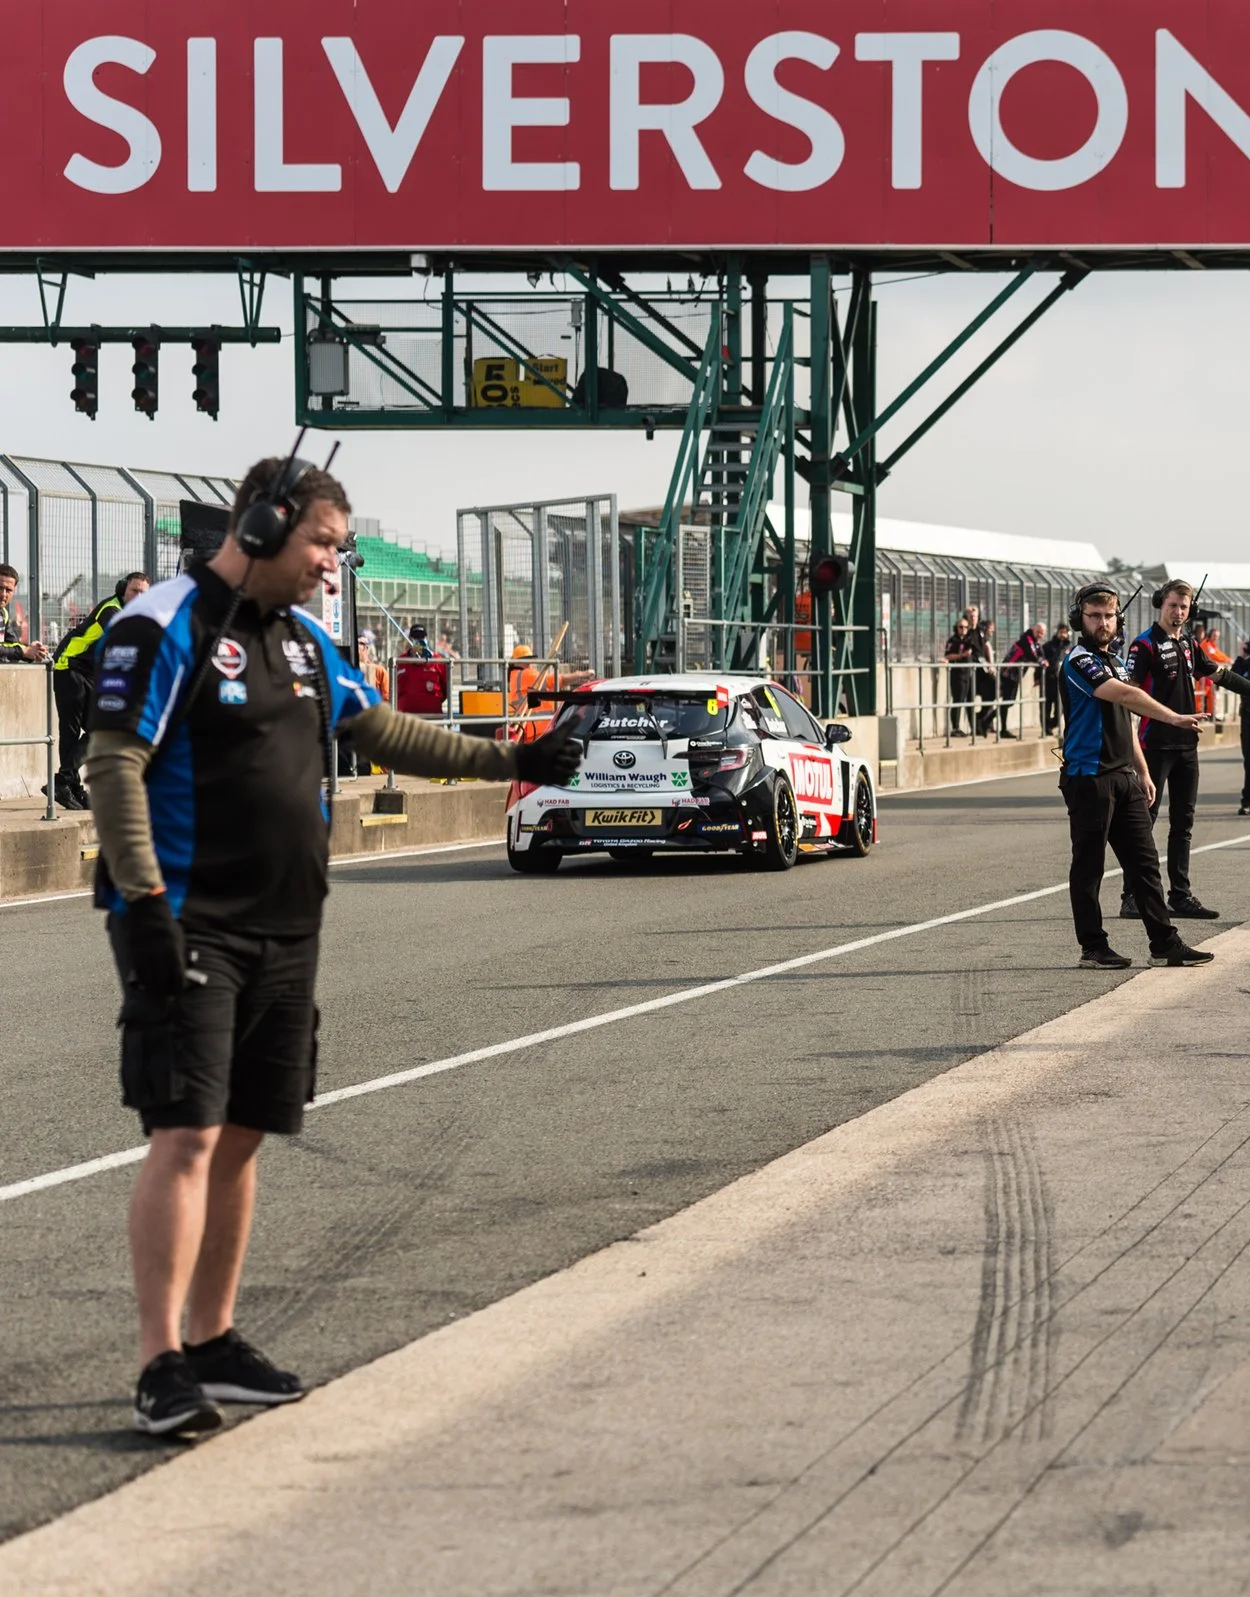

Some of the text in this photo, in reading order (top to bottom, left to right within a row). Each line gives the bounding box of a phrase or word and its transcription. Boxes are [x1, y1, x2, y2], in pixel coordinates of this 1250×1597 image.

[707, 699, 719, 716] 6
[598, 716, 668, 729] Butcher
[584, 772, 667, 783] William Waugh
[794, 757, 833, 800] MOTUL
[702, 824, 740, 833] GOODYEAR
